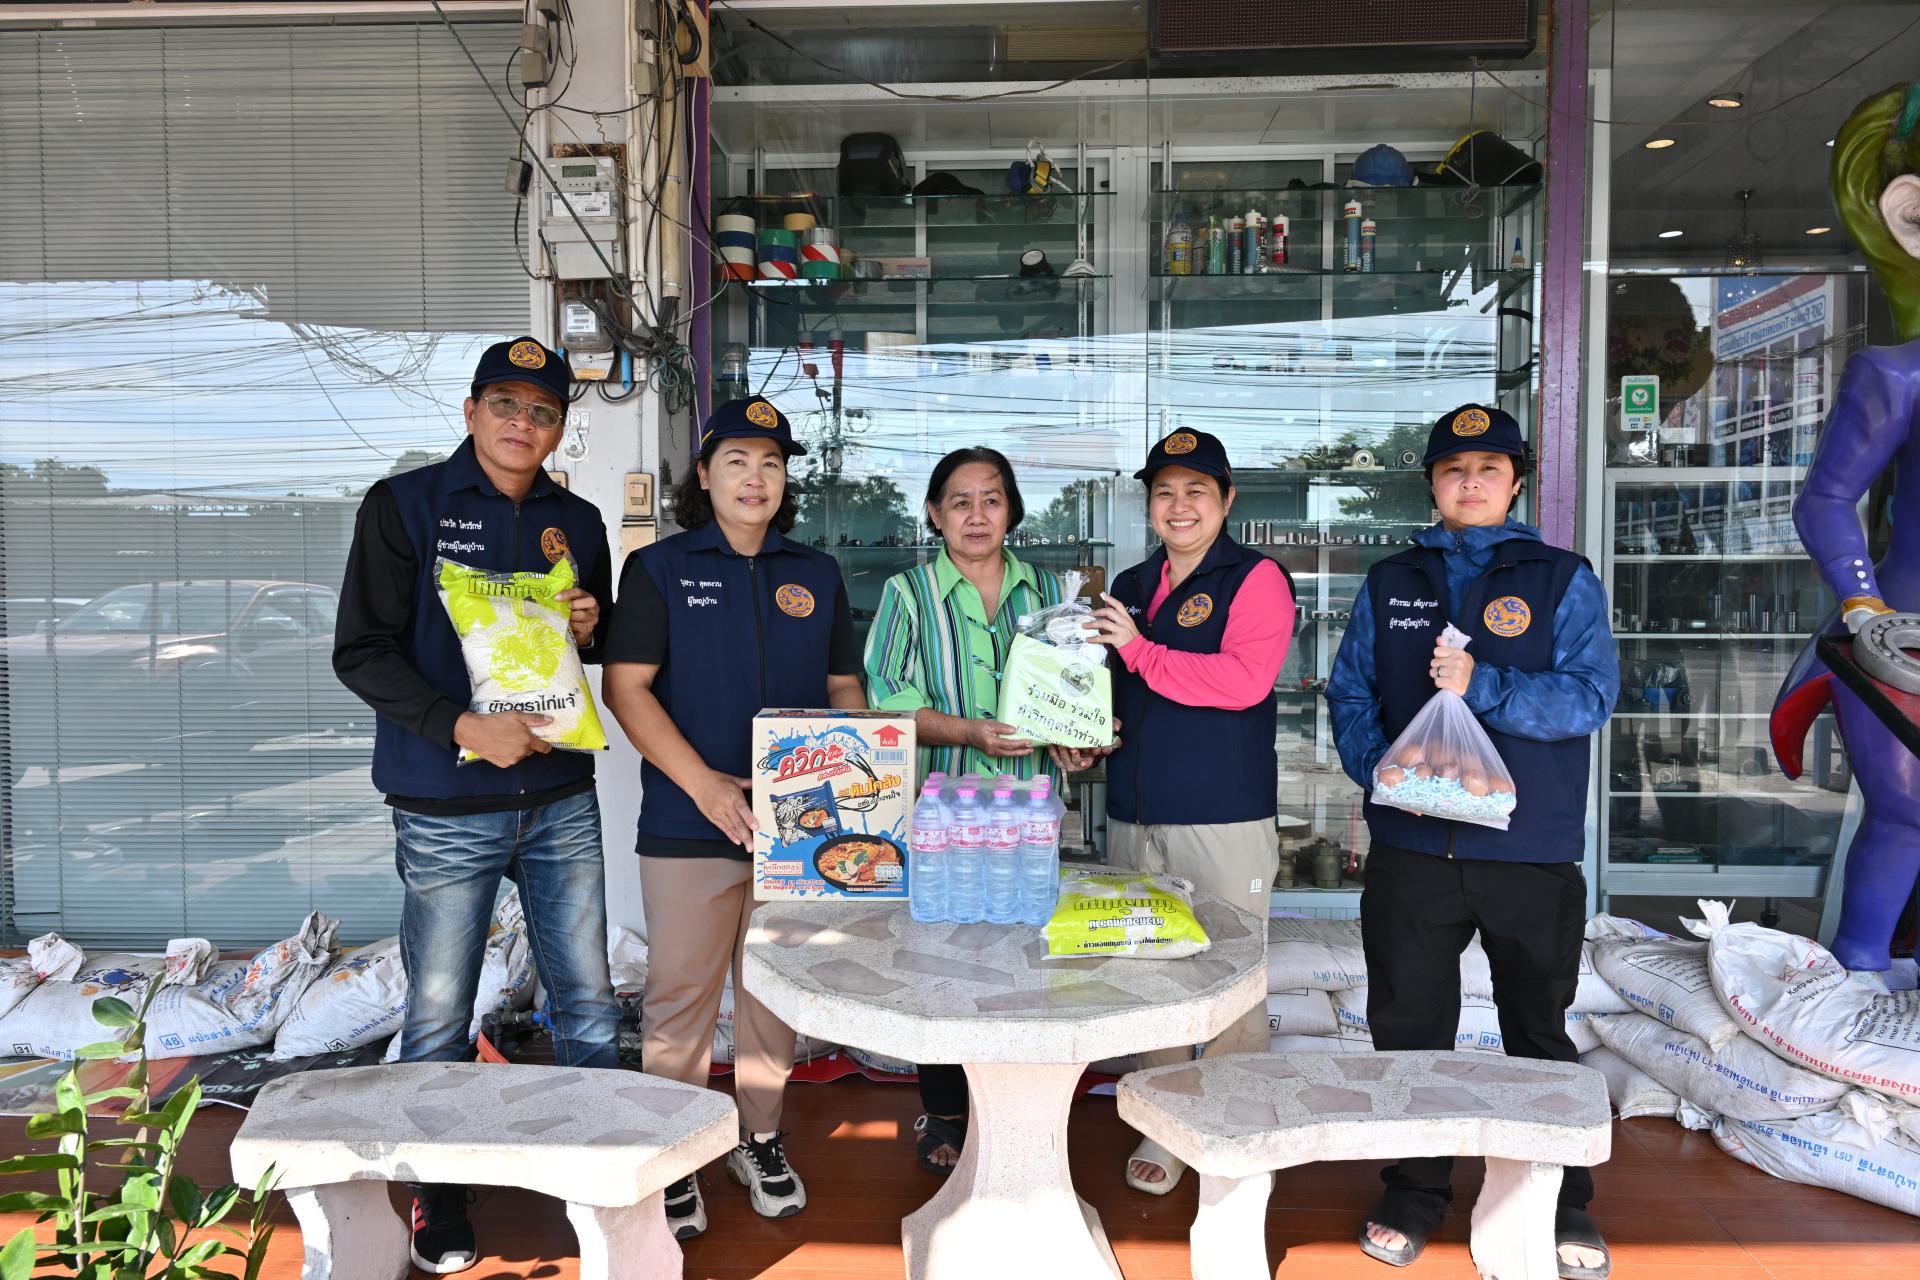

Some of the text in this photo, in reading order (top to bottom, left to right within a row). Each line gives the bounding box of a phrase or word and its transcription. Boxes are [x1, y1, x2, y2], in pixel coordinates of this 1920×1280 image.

[1027, 684, 1106, 726] ร่วมมือ ร่วมใจ
[778, 746, 827, 776] ควิก
[165, 1037, 180, 1047] 48
[1482, 1035, 1498, 1046] 48
[16, 1046, 30, 1054] 31
[1834, 1149, 1854, 1162] ตรา
[1856, 1157, 1918, 1191] แป้งสาลี
